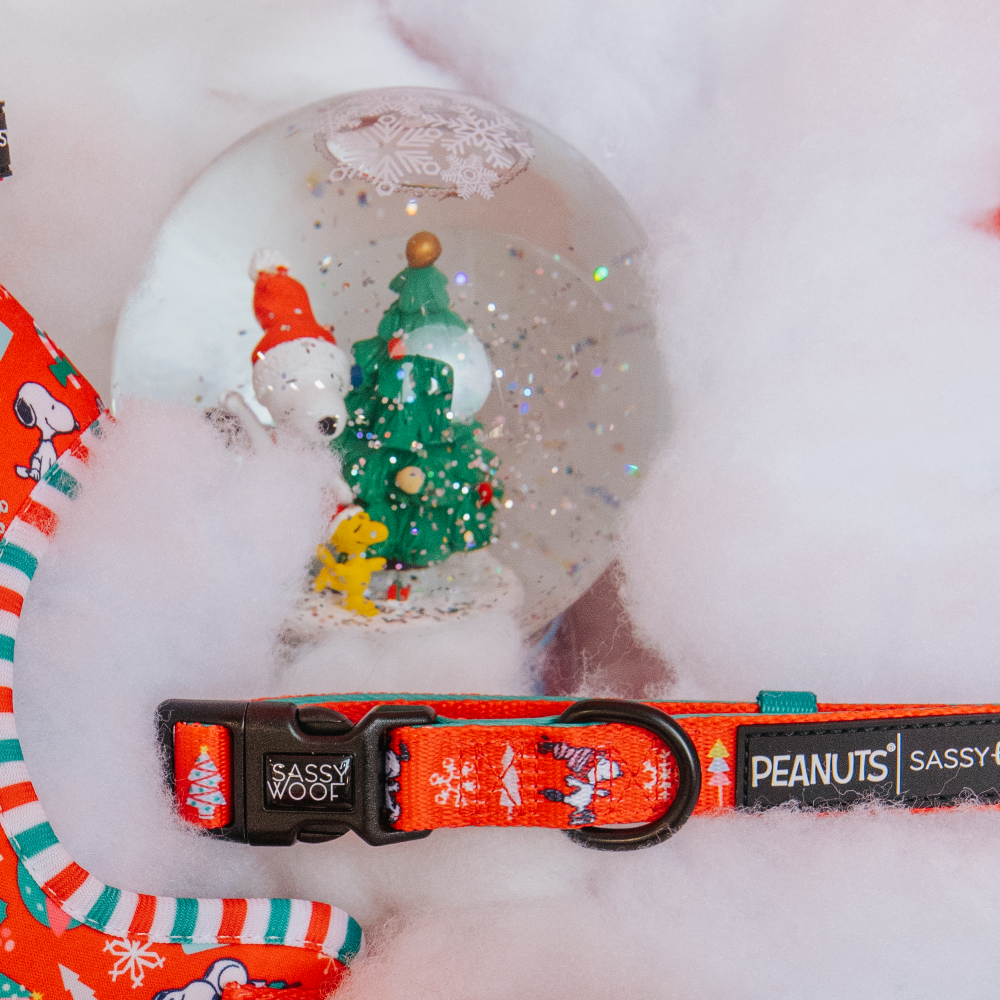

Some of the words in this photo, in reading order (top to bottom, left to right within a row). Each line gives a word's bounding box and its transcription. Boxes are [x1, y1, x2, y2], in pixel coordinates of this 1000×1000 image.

[909, 746, 990, 772] SASSY
[272, 761, 349, 783] SASSY
[266, 780, 345, 802] WOOF
